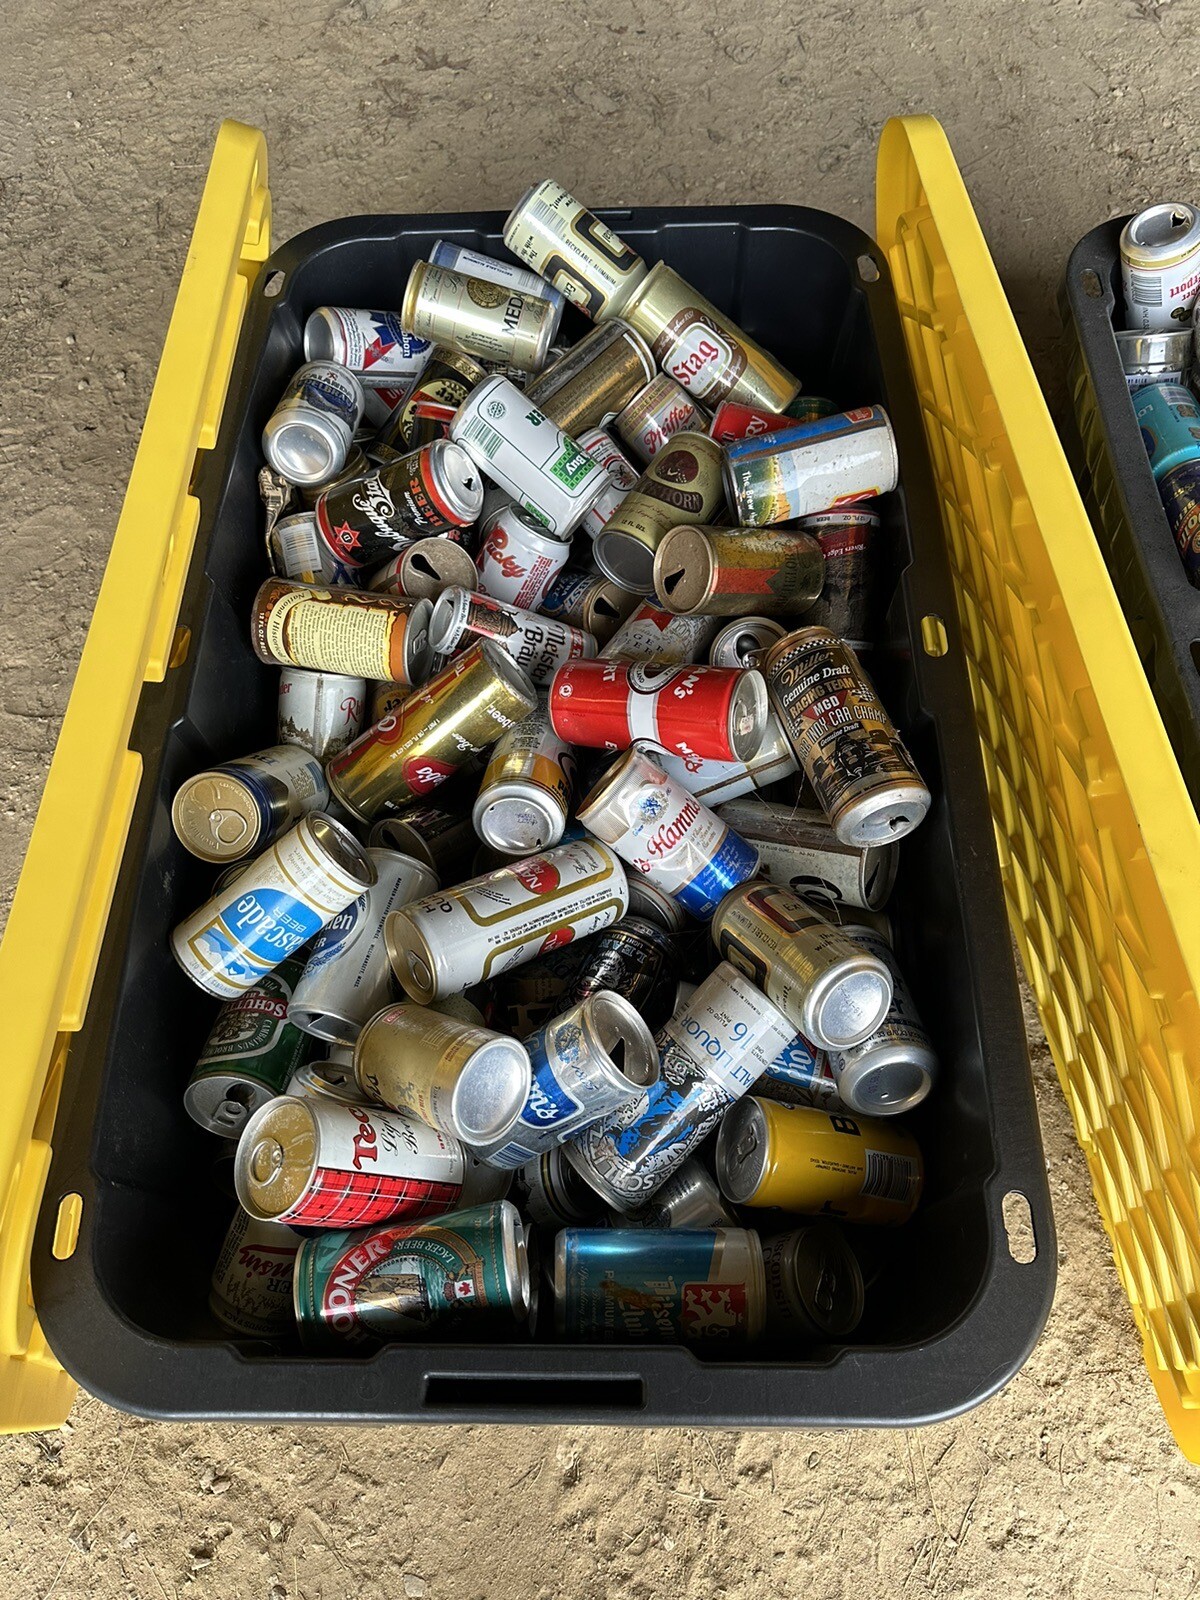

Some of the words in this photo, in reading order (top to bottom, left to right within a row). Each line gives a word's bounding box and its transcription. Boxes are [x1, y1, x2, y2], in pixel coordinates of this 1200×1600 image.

[672, 340, 720, 386] Stag
[643, 403, 695, 455] Pfeiffer
[403, 491, 428, 526] Premium
[409, 477, 443, 527] BEER
[518, 625, 544, 668] Bräu
[536, 623, 566, 680] Meister
[781, 651, 834, 686] Miller
[783, 673, 821, 707] Genuine
[822, 664, 851, 678] Draft
[789, 681, 826, 719] RACING
[824, 676, 855, 693] TEAM
[812, 695, 840, 717] MGD
[806, 714, 829, 745] INDY
[828, 705, 853, 727] CAR
[272, 907, 307, 932] BEER
[681, 1016, 737, 1068] LIQUOR
[728, 1021, 755, 1051] 16
[350, 1106, 379, 1170] Tec
[381, 1111, 403, 1157] Ligh
[424, 1241, 457, 1265] LAGER
[643, 1275, 679, 1345] Pilsen
